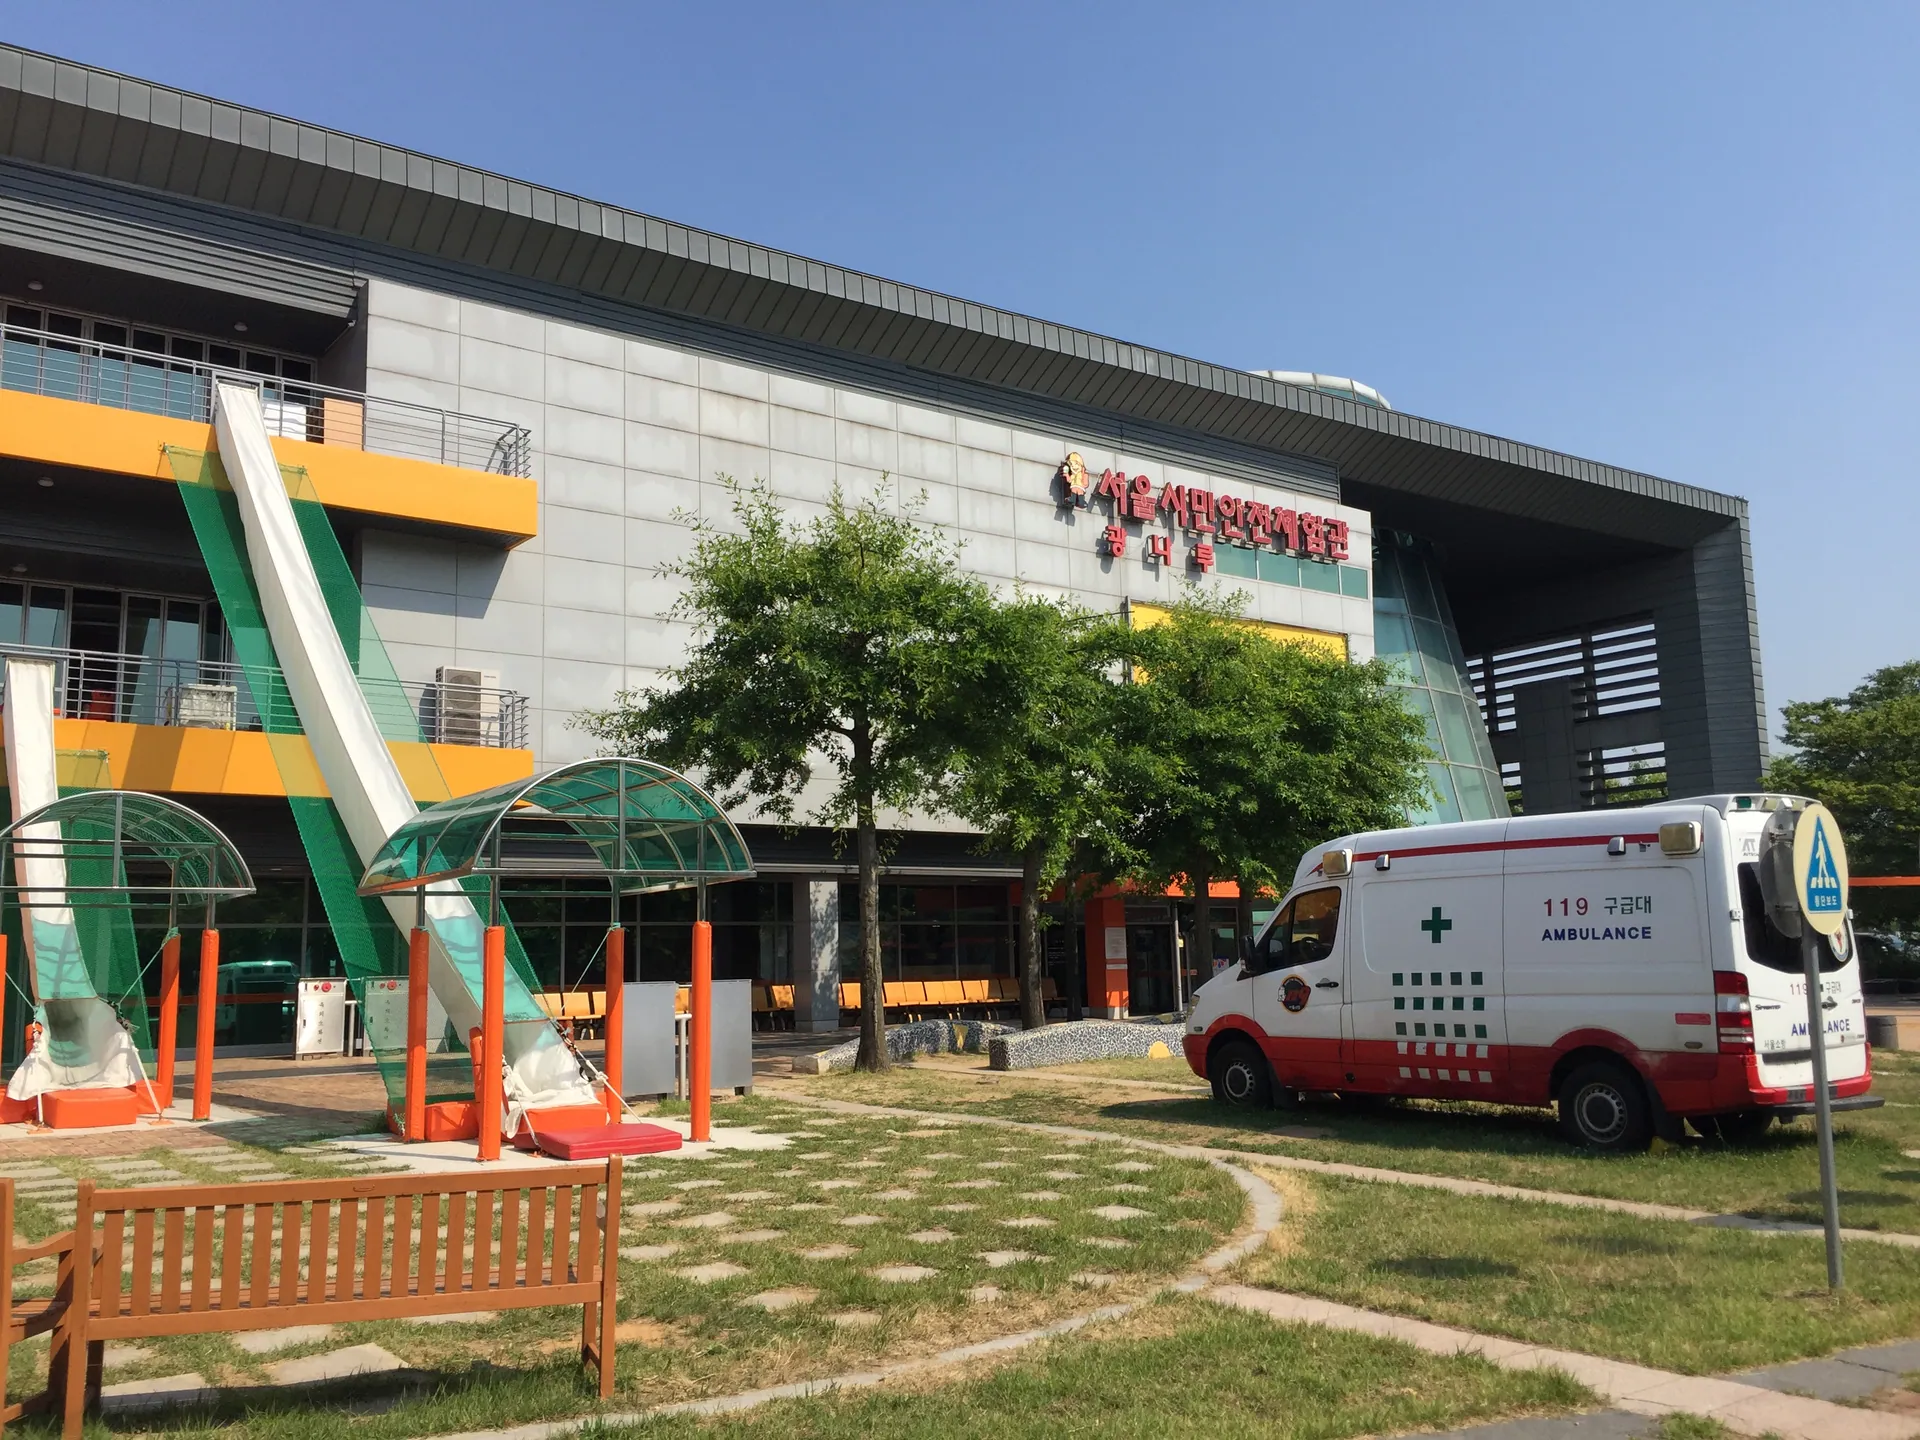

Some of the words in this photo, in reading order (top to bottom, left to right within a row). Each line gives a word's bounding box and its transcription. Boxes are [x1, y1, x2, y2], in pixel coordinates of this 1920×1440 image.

[1100, 468, 1349, 560] 서울시민안전체험관
[1105, 525, 1214, 573] 광나루
[1543, 897, 1588, 916] 119
[1604, 895, 1652, 915] 구급대
[1541, 926, 1652, 941] AMBULANCE
